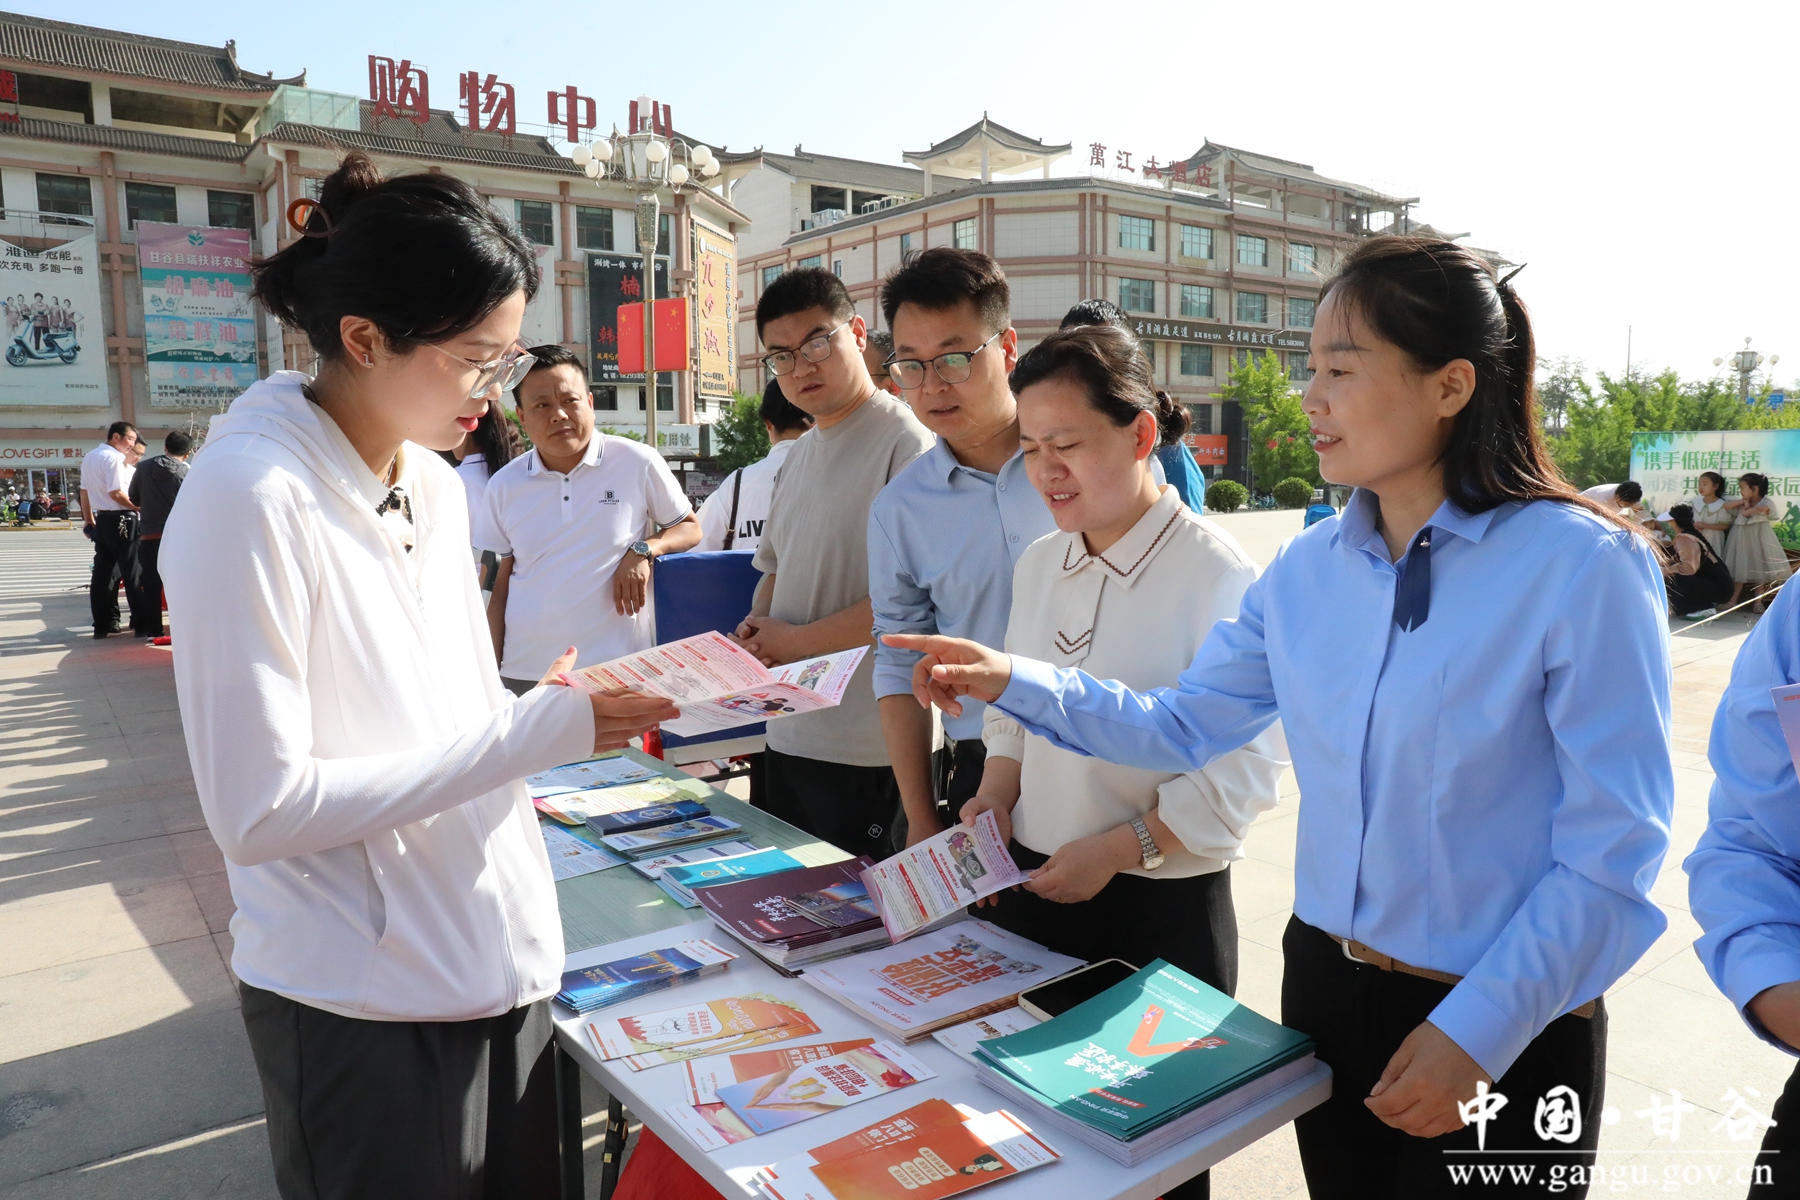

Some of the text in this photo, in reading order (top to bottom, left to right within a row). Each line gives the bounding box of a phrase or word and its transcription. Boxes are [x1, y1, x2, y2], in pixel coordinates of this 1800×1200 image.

[165, 275, 234, 298] 胡麻油
[168, 320, 238, 341] 菜籽油
[662, 432, 692, 446] 用社
[0, 448, 31, 459] LOVE
[33, 448, 60, 459] GIFT
[1644, 450, 1761, 471] 携手低碳生活
[738, 519, 767, 539] LIV
[875, 958, 969, 999] 好保险
